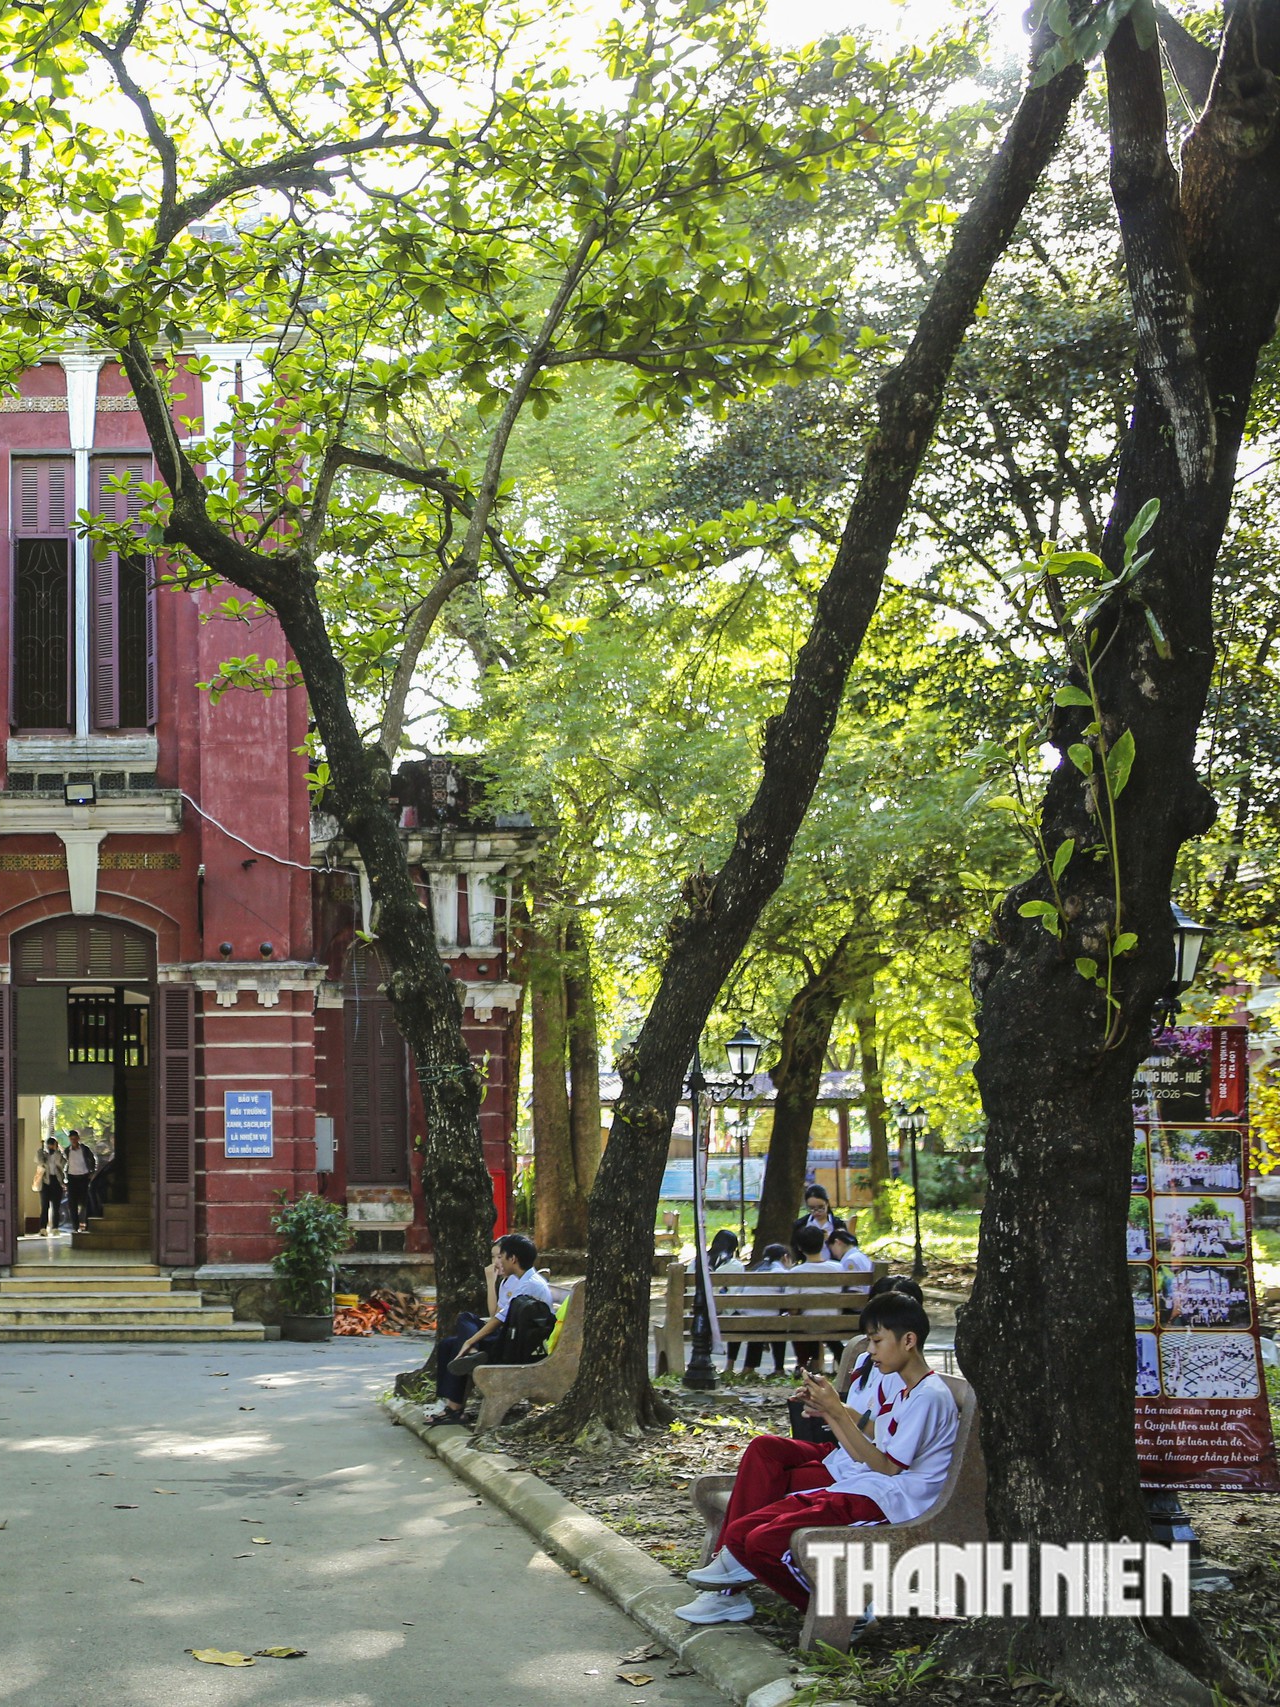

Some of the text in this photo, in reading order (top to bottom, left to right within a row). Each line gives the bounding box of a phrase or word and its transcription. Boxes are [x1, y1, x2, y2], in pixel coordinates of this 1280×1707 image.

[1161, 1071, 1178, 1086] HỌC
[1185, 1069, 1204, 1083] HUẾ
[1144, 1405, 1157, 1415] ba
[1183, 1406, 1202, 1415] năm
[1204, 1407, 1228, 1418] rạng
[1178, 1421, 1198, 1431] theo
[1156, 1436, 1174, 1447] bạn
[1187, 1436, 1208, 1446] luôn
[1164, 1452, 1198, 1464] thương
